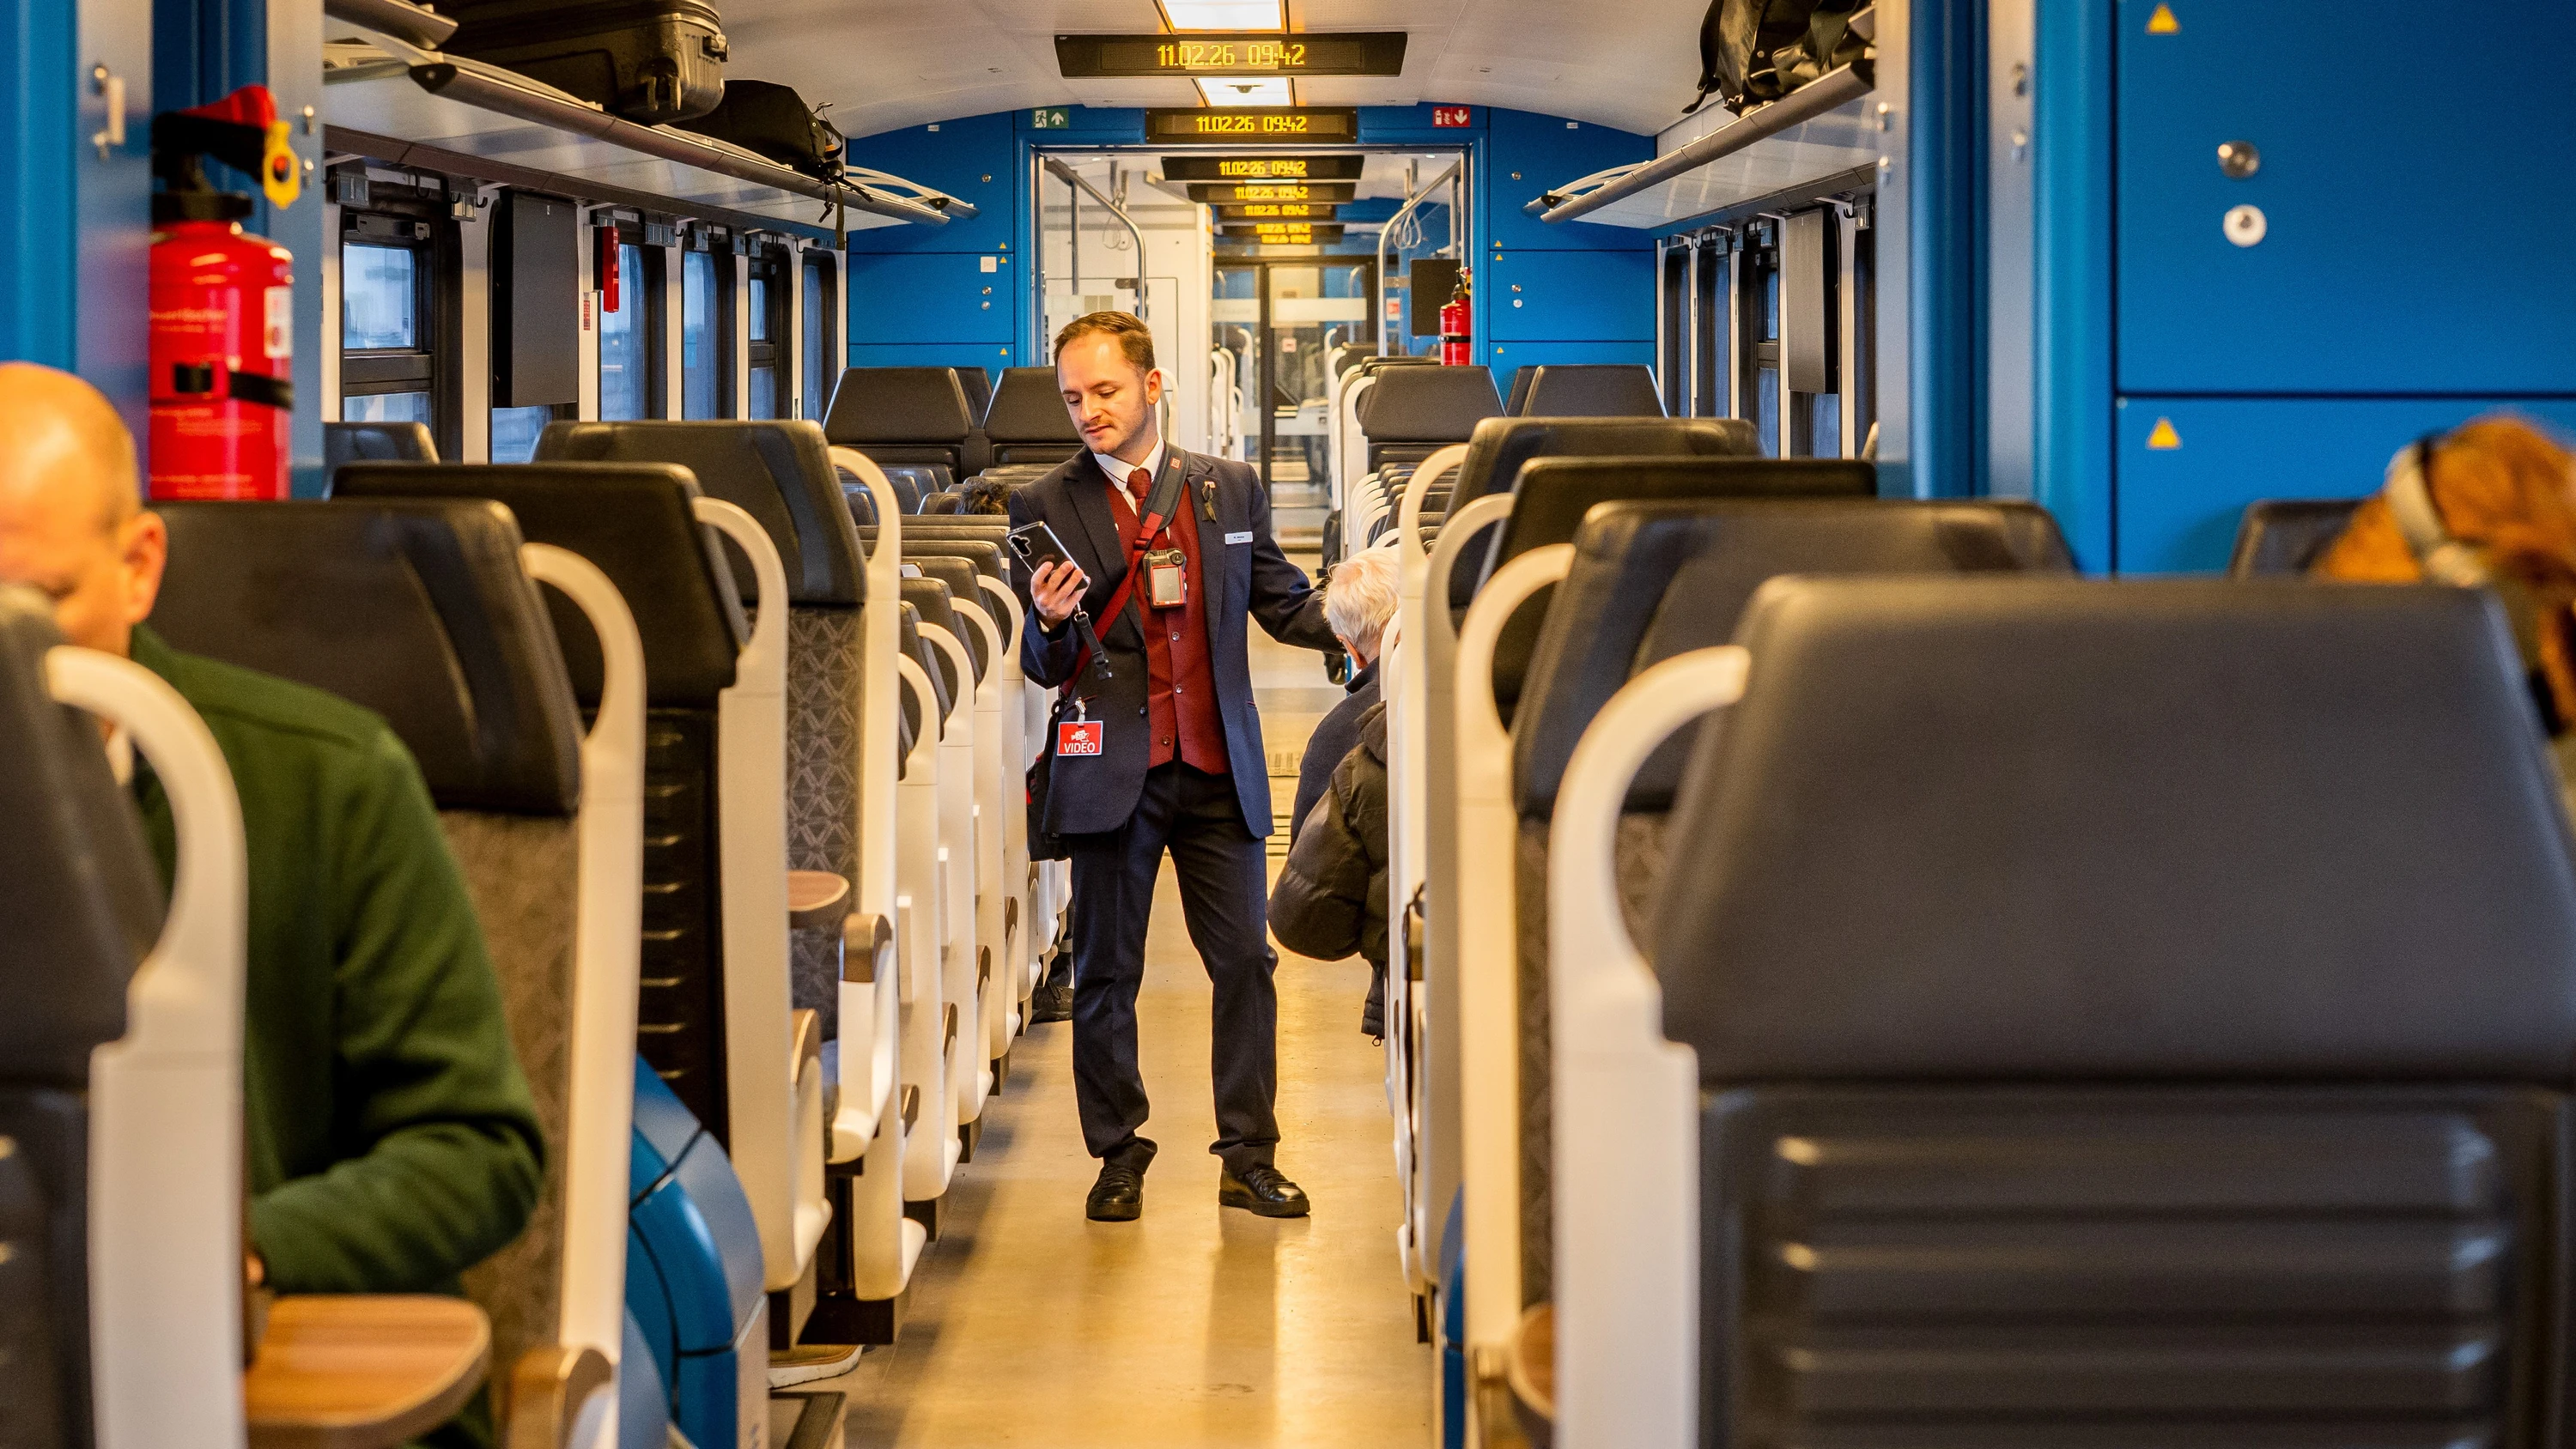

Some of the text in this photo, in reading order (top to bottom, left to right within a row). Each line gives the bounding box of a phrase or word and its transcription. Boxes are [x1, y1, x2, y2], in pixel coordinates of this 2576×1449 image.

[1157, 44, 1305, 66] 11.02.26 09:42
[1196, 116, 1307, 132] 11.02.26 09:42
[1218, 161, 1307, 176] 11.02.26 09:42
[1064, 742, 1096, 754] VIDEO
